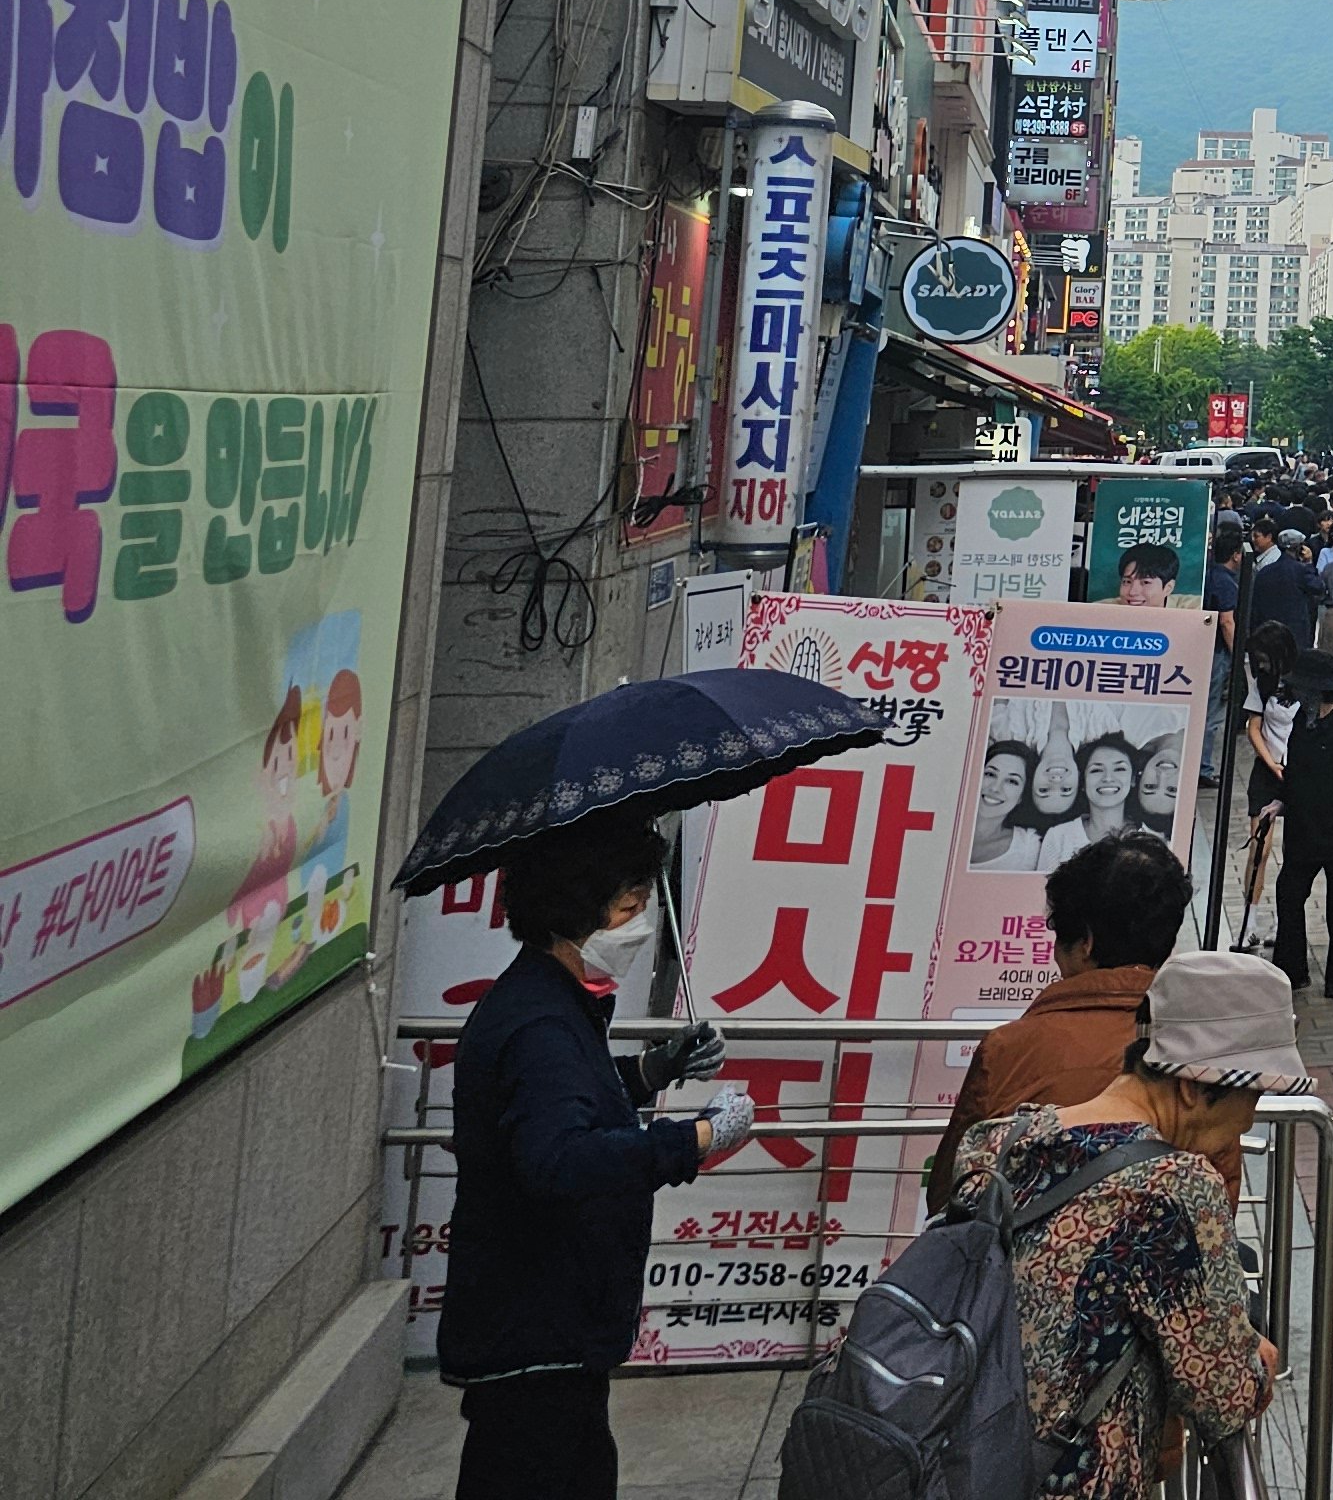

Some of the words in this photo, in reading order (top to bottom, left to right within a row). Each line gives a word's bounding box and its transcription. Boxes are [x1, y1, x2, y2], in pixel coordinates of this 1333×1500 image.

[1070, 59, 1092, 74] 4F
[1017, 95, 1087, 120] 소담村
[1013, 147, 1050, 165] 구름
[1013, 167, 1083, 187] 빌리어드
[1064, 188, 1081, 201] 6F
[916, 282, 1003, 300] SALADY
[1075, 294, 1096, 305] BAR
[735, 134, 818, 474] 스포츠마사지
[1069, 310, 1100, 328] PC
[729, 478, 787, 526] 지하
[1037, 631, 1074, 647] ONE
[1075, 633, 1110, 648] DAY
[1111, 636, 1163, 651] CLASS
[995, 655, 1193, 696] 원데이클래스
[954, 941, 1026, 965] 요가는
[998, 970, 1034, 986] 40대
[648, 1260, 869, 1290] 010-7358-6924
